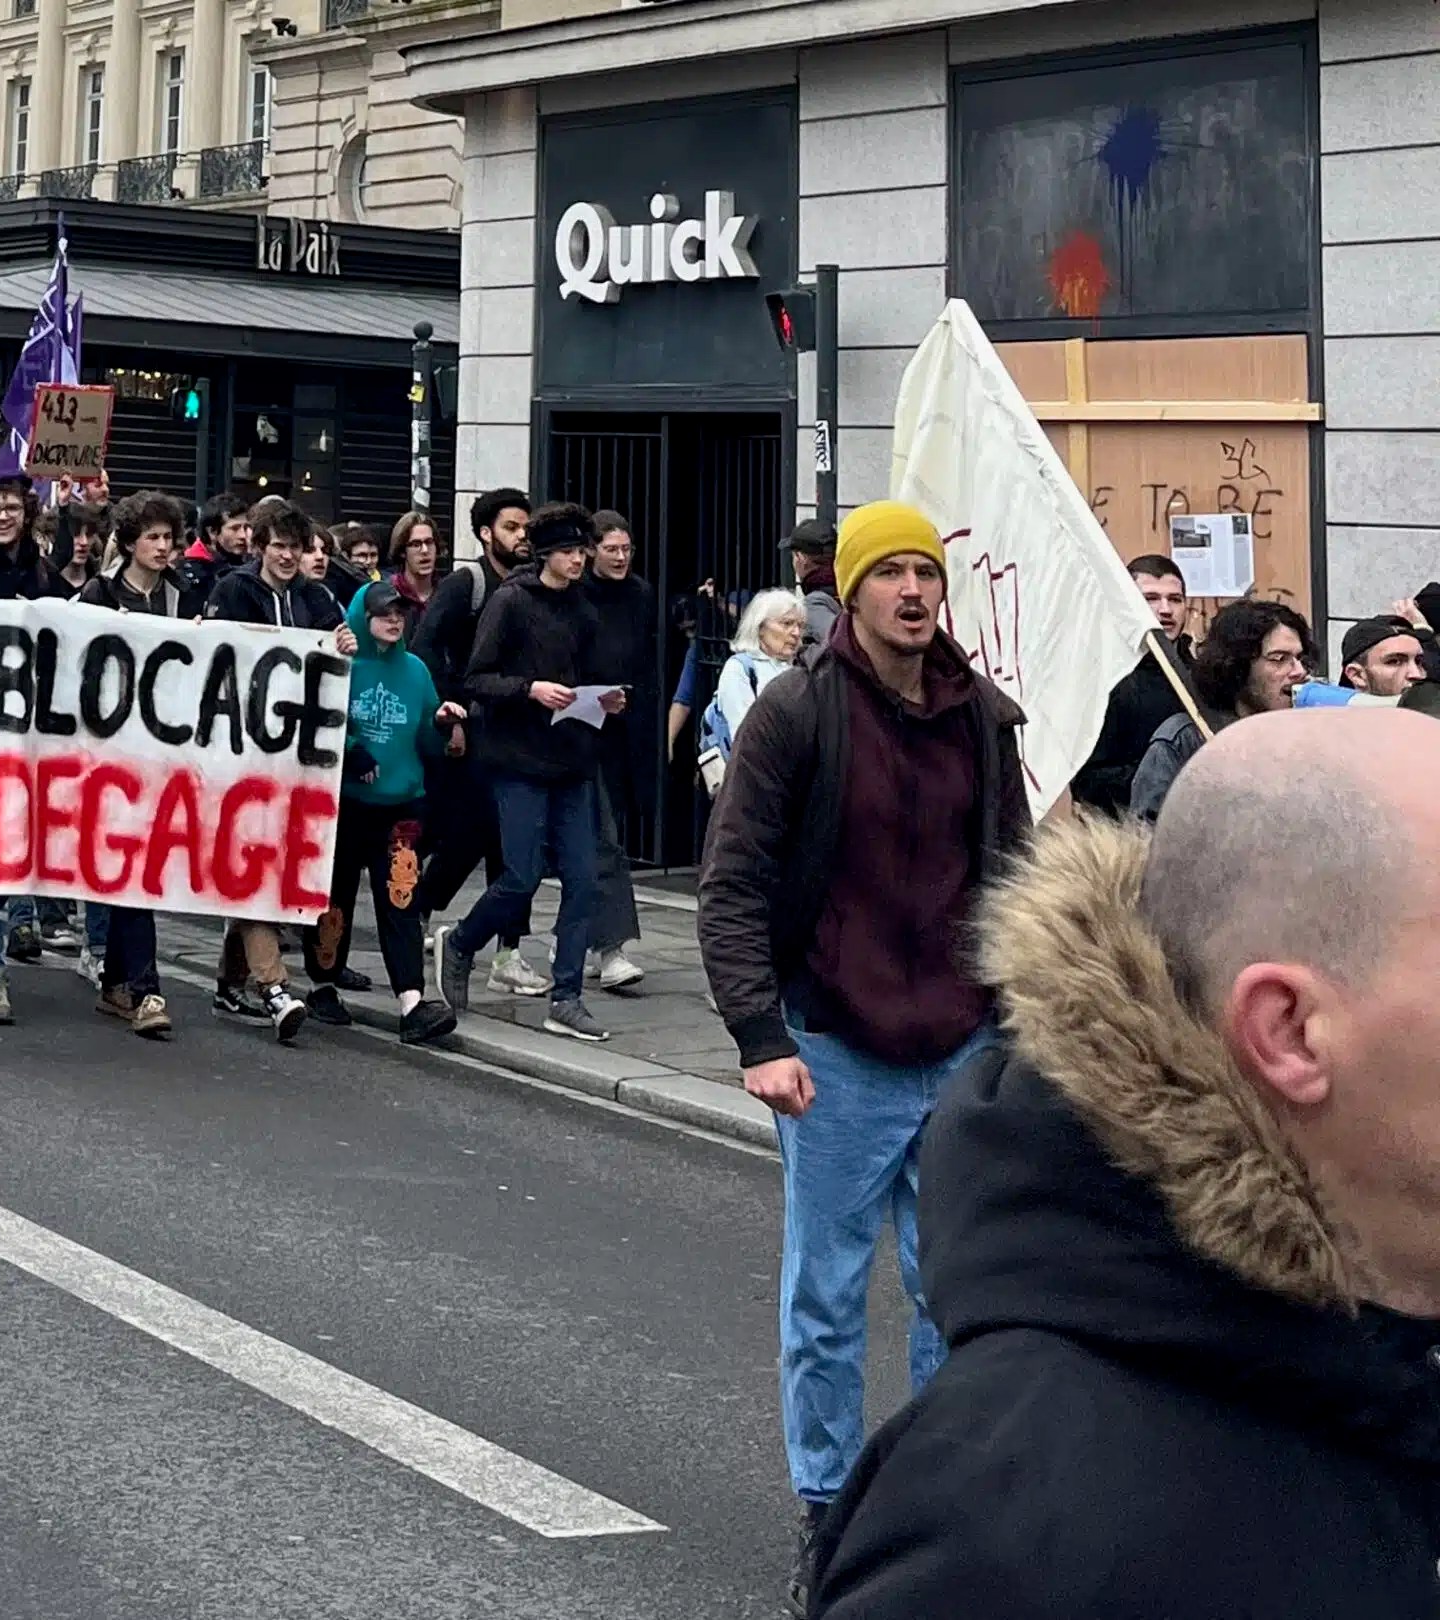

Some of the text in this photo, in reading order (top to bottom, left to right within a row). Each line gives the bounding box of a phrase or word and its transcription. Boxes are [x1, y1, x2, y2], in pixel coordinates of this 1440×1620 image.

[257, 214, 341, 275] La Paix
[555, 189, 759, 303] Quick
